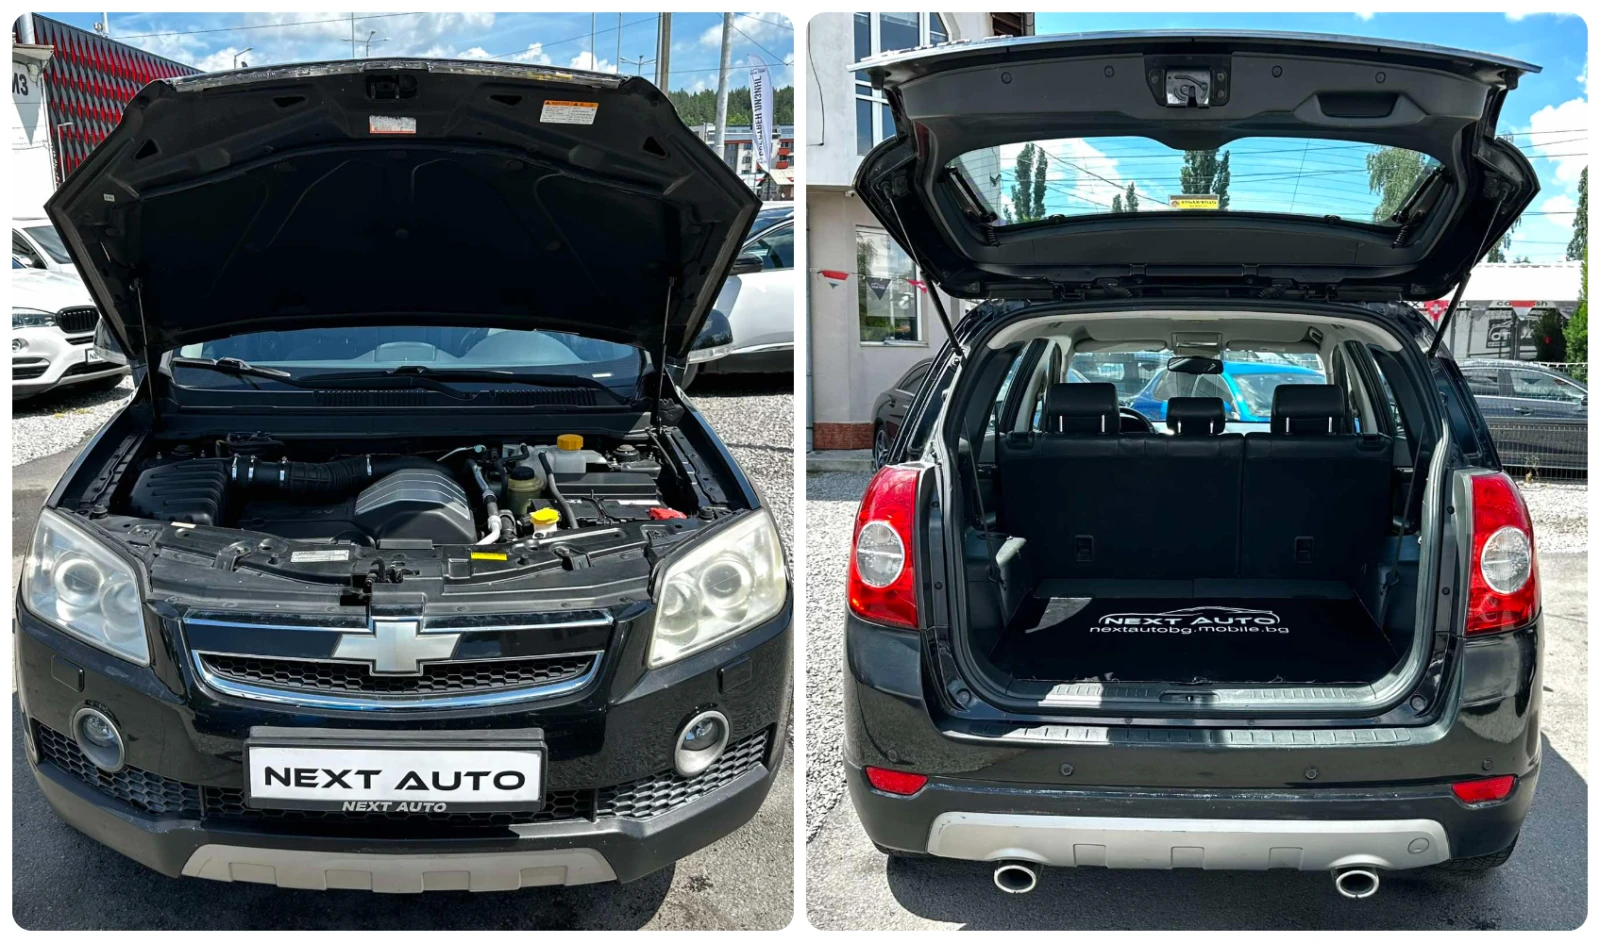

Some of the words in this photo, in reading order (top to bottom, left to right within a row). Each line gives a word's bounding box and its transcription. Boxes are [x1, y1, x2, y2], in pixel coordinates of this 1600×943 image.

[1104, 617, 1182, 625] NEXT
[1190, 616, 1276, 625] AUTO
[1089, 625, 1290, 634] nextautobg.mobile.bg
[264, 765, 383, 789] NEXT
[394, 769, 526, 791] AUTO
[341, 800, 392, 812] NEXT
[396, 801, 447, 813] AUTO
